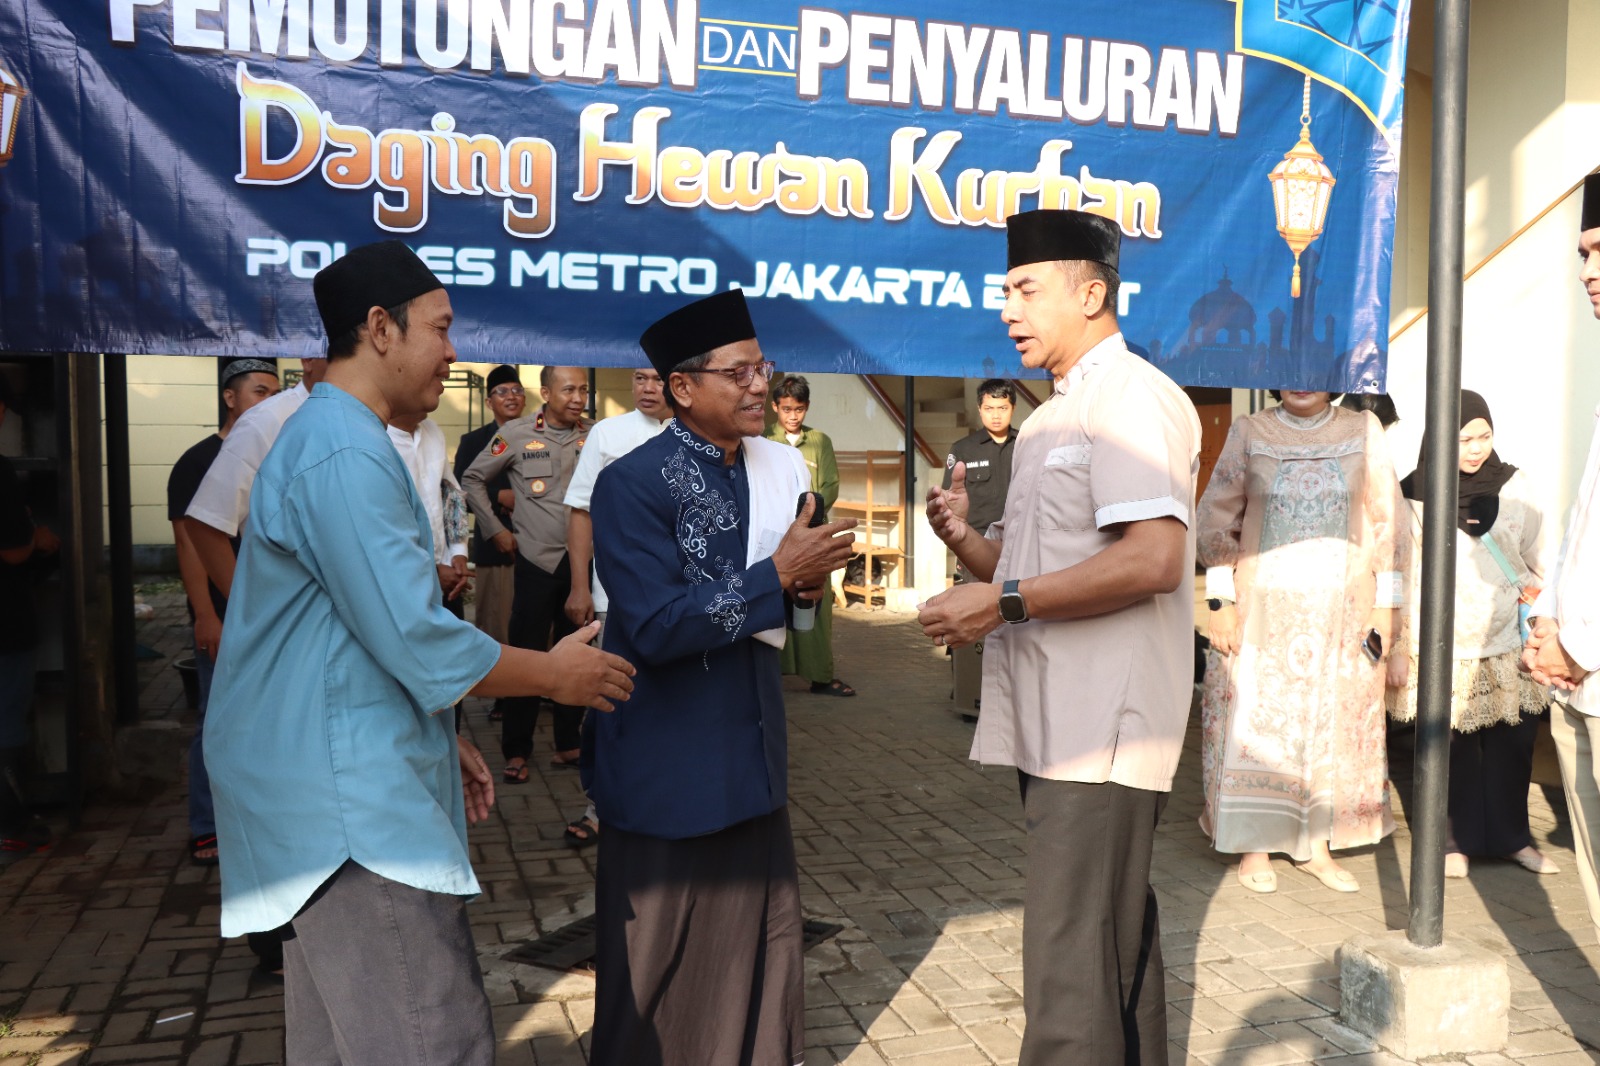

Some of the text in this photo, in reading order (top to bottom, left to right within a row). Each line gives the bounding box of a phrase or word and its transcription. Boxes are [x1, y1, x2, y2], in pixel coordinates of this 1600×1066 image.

[703, 26, 796, 70] DAN
[799, 9, 1243, 134] PENYALURAN
[235, 62, 1163, 239] Daging Hewan Kurban
[246, 238, 496, 286] POES
[510, 248, 718, 295] METRO
[728, 258, 972, 308] JAKARTA
[522, 451, 550, 460] BANGUN
